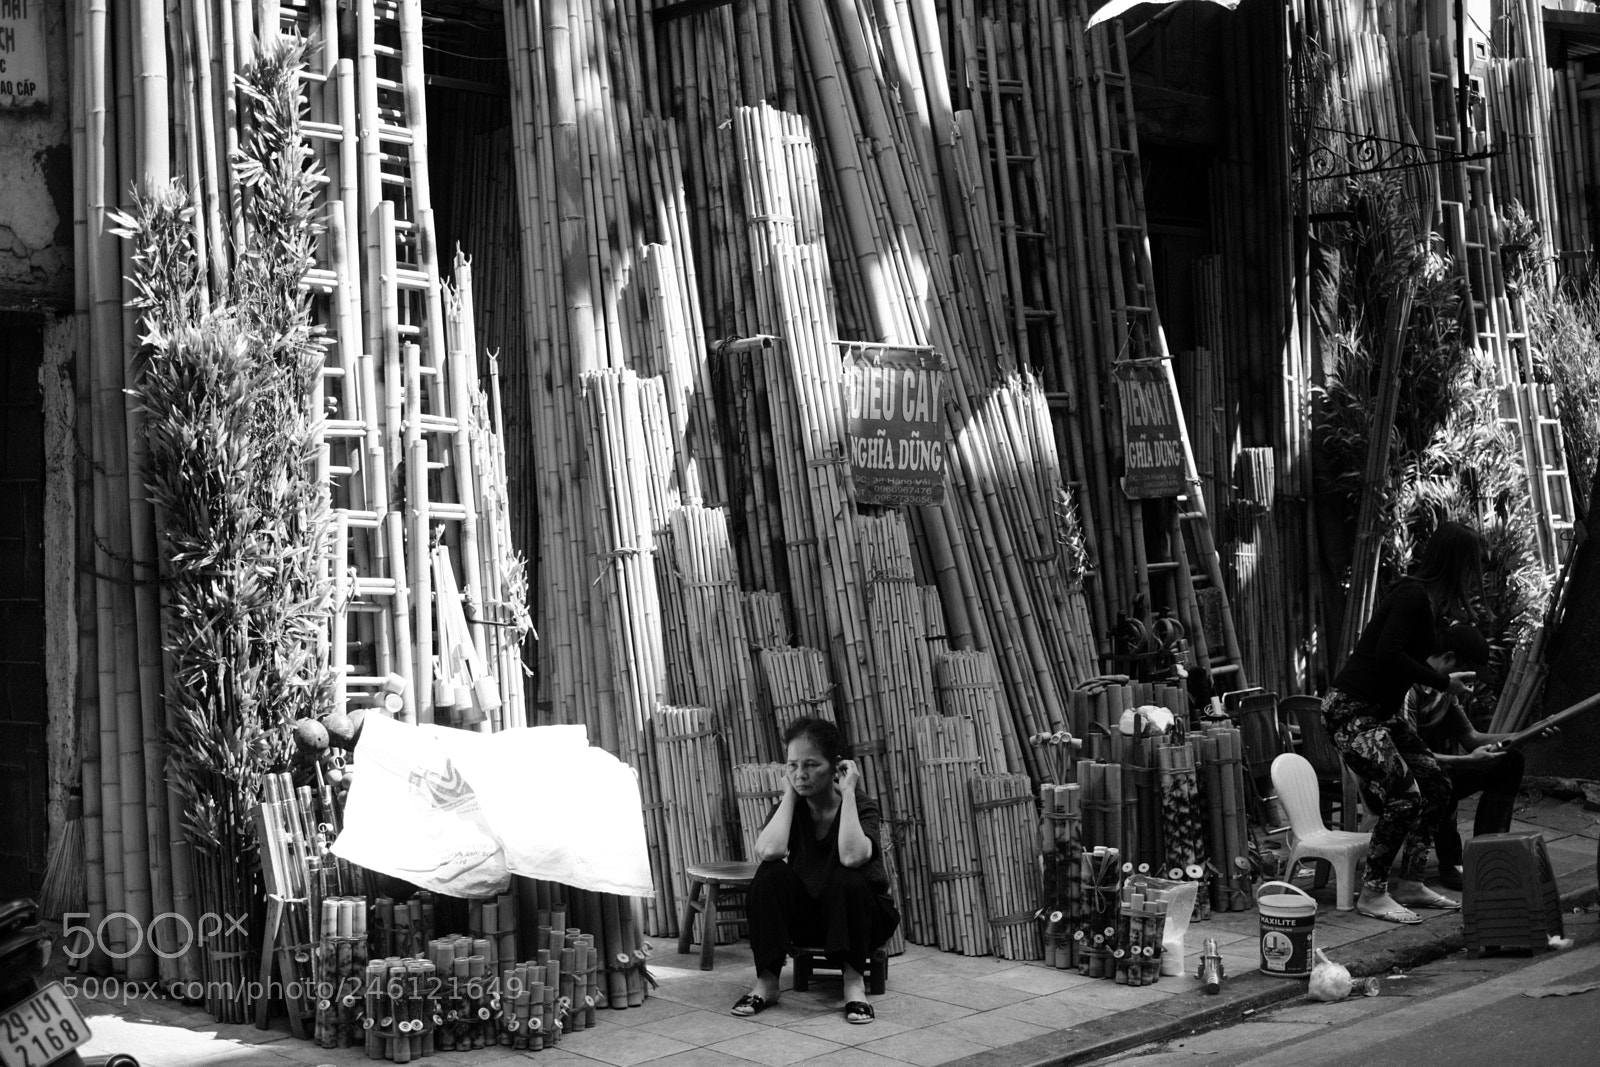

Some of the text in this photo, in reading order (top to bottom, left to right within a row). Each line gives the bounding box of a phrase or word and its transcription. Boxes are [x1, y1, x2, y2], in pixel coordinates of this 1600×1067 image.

[850, 428, 942, 472] NGHĨA DŨNG
[1127, 433, 1154, 469] GHĨA
[1260, 916, 1297, 926] MAXILITE
[15, 1018, 79, 1067] 2168
